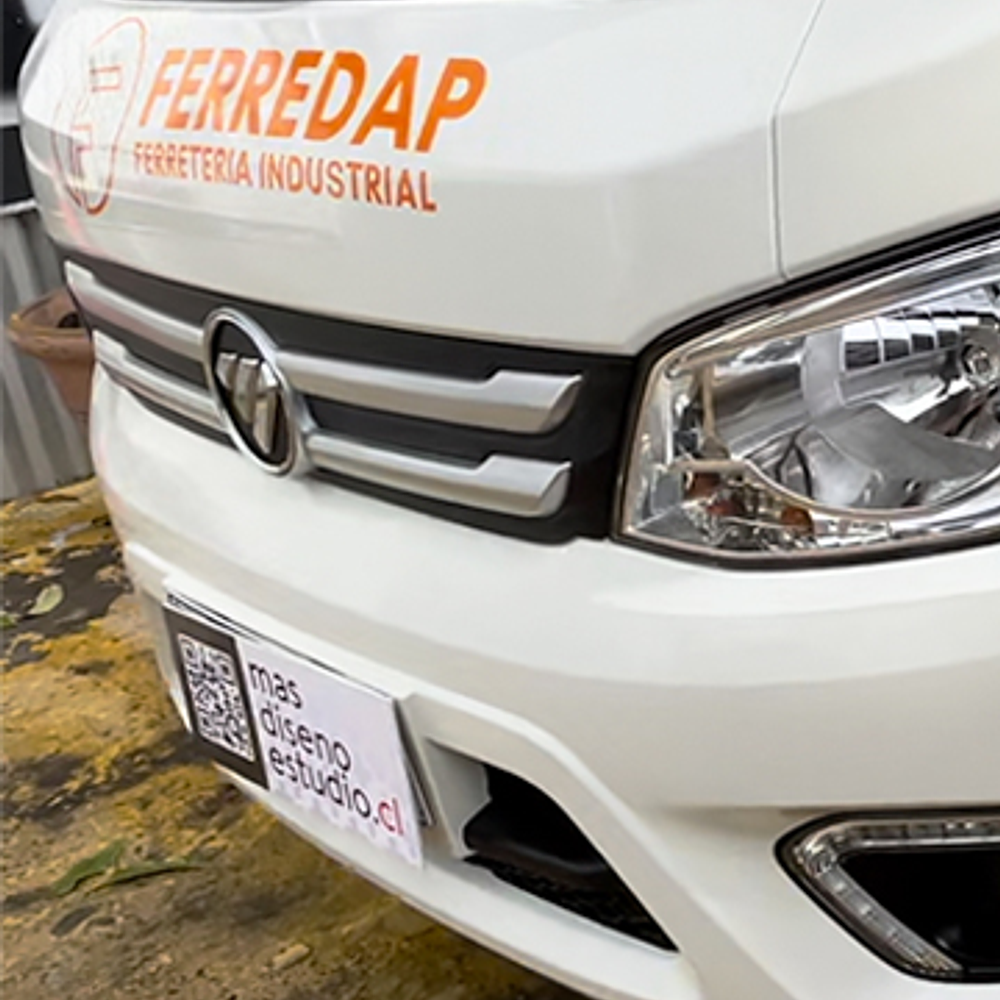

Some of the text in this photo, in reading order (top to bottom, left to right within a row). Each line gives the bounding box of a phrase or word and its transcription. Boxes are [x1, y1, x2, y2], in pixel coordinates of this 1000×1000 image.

[138, 47, 488, 153] FERREDAP
[133, 141, 438, 212] FERRETERIA INDUSTRIAL
[248, 662, 302, 710] mas
[259, 699, 352, 772] diseno
[269, 745, 405, 836] estudio.cl
